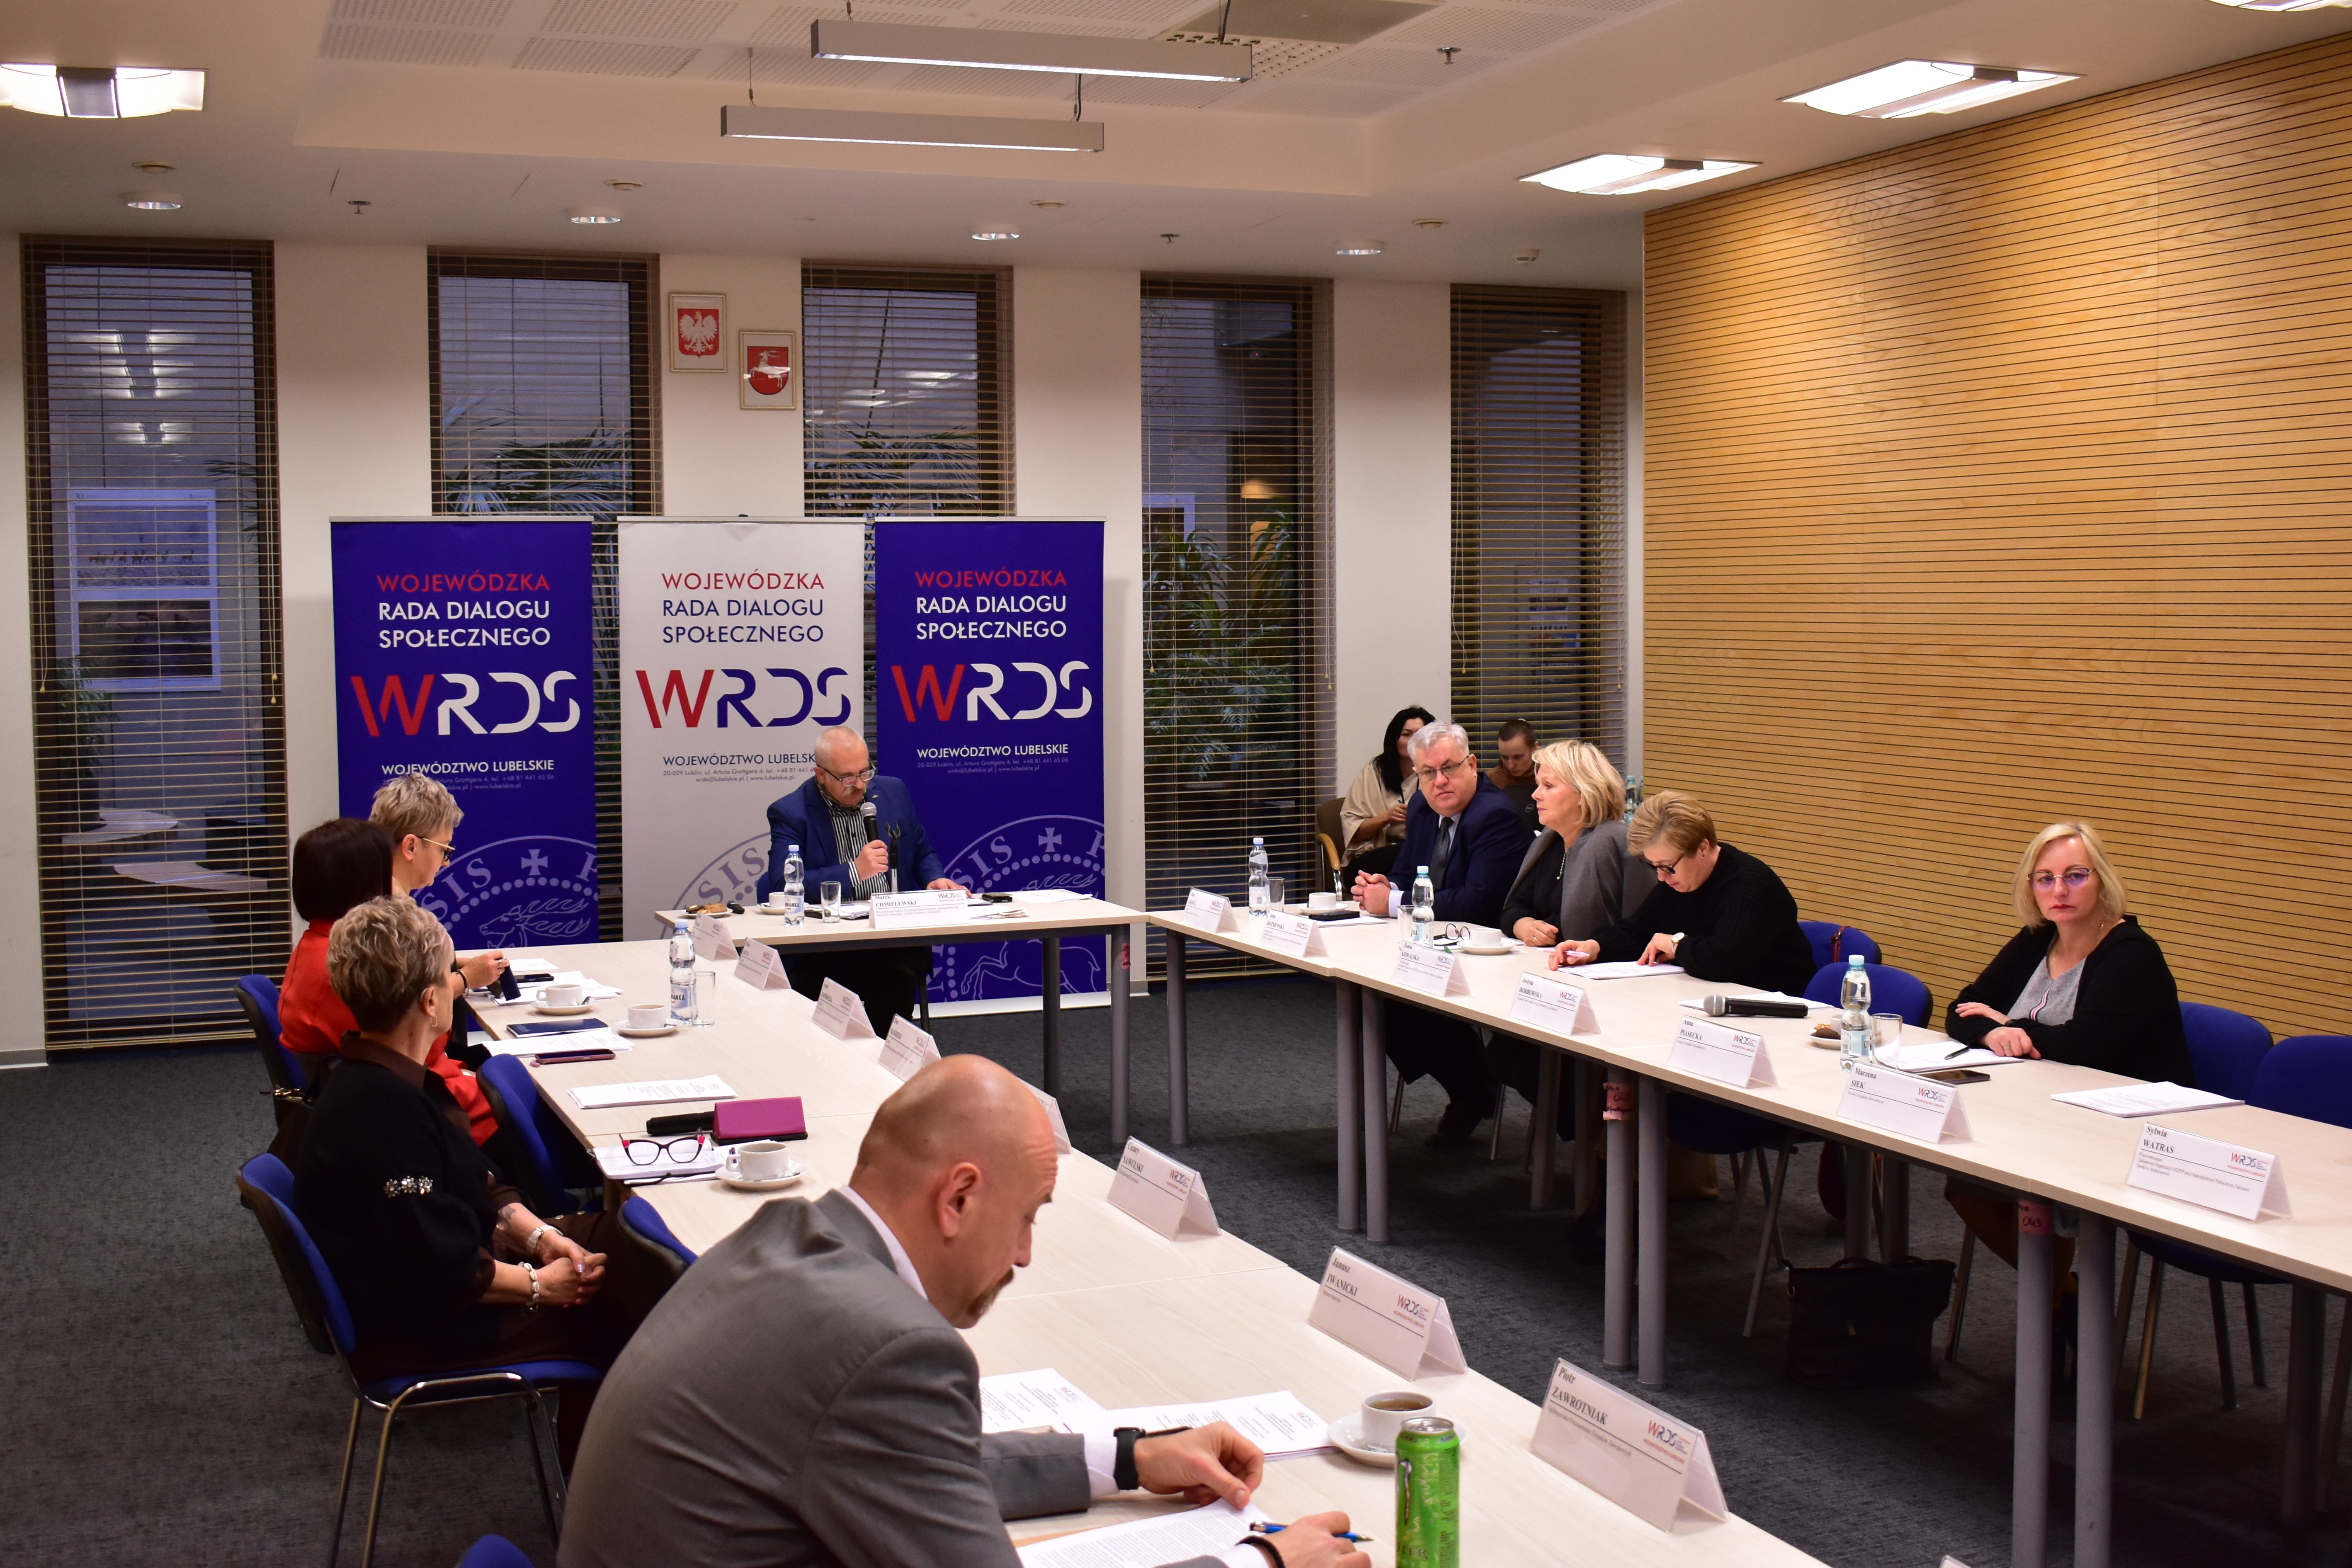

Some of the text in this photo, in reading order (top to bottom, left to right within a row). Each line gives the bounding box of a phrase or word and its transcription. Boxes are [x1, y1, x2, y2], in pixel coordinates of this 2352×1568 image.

[377, 570, 550, 592] WOJEWÓDZKA
[662, 569, 825, 590] WOJEWÓDZKA
[915, 567, 1067, 587] WOJEWÓDZKA
[379, 600, 550, 620] RADA DIALOGU
[663, 599, 823, 616] RADA DIALOGU
[917, 595, 1066, 614] RADA DIALOGU
[379, 627, 551, 648] SPOŁECZNEGO
[663, 625, 823, 643] SPOŁECZNEGO
[916, 620, 1067, 640] SPOŁECZNEGO
[635, 667, 851, 728] WRDS
[891, 661, 1092, 722] WRDS
[350, 670, 580, 737] WRDS
[663, 753, 816, 766] WOJEWÓDZTWO LUBELSK
[917, 744, 1068, 758] WOJEWÓDZTWO LUBELSKIE
[382, 760, 554, 775] WOJEWÓDZTWO LUBELSKIE
[1680, 1029, 1702, 1041] PIASECKA
[1855, 1068, 1876, 1079] Marzena
[1850, 1080, 1865, 1089] SIEK
[1918, 1087, 1939, 1100] WRDS
[2146, 1126, 2167, 1138] Sylwia
[2143, 1139, 2175, 1153] WATRAS
[1122, 1155, 1144, 1172] SAWULSKI
[2231, 1153, 2257, 1168] WRDS
[1332, 1257, 1351, 1274] Janusz
[1326, 1273, 1359, 1296] IWANICKI
[1397, 1294, 1420, 1315] WRDS
[1558, 1367, 1576, 1384] Piotr
[1551, 1386, 1609, 1425] ZAWROTNIAK
[1648, 1420, 1677, 1446] WRDS
